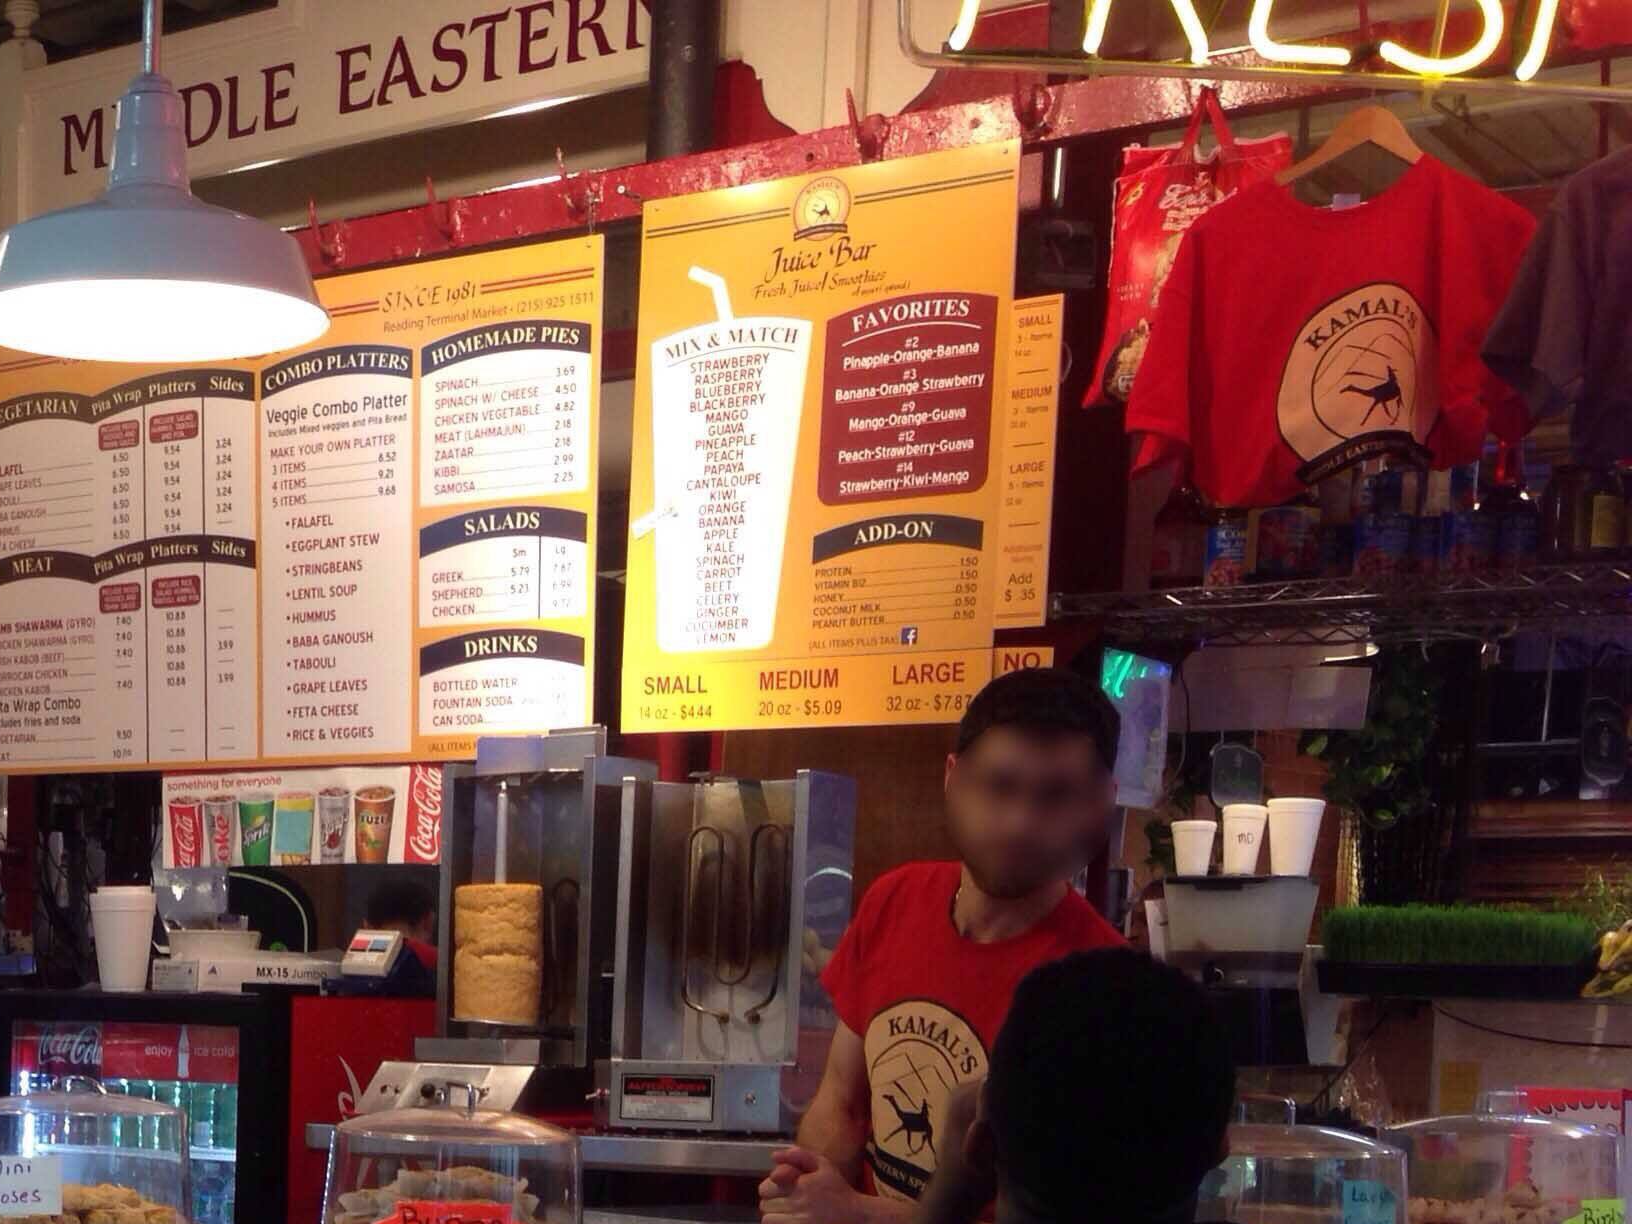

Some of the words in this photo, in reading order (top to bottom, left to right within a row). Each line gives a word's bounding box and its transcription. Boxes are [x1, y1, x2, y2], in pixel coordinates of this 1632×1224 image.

[63, 63, 299, 175] MDDLE
[851, 299, 970, 333] FAVORITES
[1304, 297, 1418, 351] KAMAL'S
[432, 327, 537, 366] HOMEMADE
[541, 326, 580, 345] PIES
[665, 338, 702, 359] MIX
[728, 327, 799, 344] MATCH
[690, 352, 770, 374] STRAWBERRY
[265, 355, 323, 392] COMBO
[327, 352, 409, 372] PLATTERS
[695, 368, 763, 385] RASPBERRY
[435, 378, 479, 393] SPINACH
[695, 381, 762, 399] BLUEBERRY
[922, 373, 985, 391] Strawberry
[112, 388, 142, 407] Wrap
[148, 379, 196, 398] Platters
[209, 377, 245, 392] Sides
[501, 386, 539, 400] CHEESE
[266, 406, 308, 425] Veggie
[312, 399, 359, 419] Combo
[363, 393, 408, 411] Platter
[690, 393, 766, 413] BLACKBERRY
[434, 412, 479, 427] CHICKEN
[481, 404, 540, 422] VEGETABLE
[706, 409, 748, 423] MANGO
[849, 407, 966, 432] Mango-Orange-Guava
[708, 422, 745, 437] GUAVA
[695, 434, 756, 450] PINEAPPLE
[706, 450, 744, 462] PEACH
[838, 438, 974, 464] Peach-Strawberry-Guava
[704, 462, 745, 475] PAPAYA
[840, 470, 969, 494] Strawberry-Kiwi-Mango
[710, 489, 737, 501] KIWI
[698, 501, 746, 515] ORANGE
[291, 515, 334, 529] FALAFEL
[464, 511, 541, 536] SALADS
[698, 514, 745, 528] BANANA
[854, 520, 935, 545] ADD-ON
[291, 537, 345, 552] EGGPLANT
[350, 533, 380, 547] STEW
[12, 557, 54, 574] MEAT
[116, 550, 145, 569] Wrap
[150, 542, 198, 558] Platters
[211, 541, 246, 558] Sides
[292, 560, 363, 577] STRINGBEANS
[815, 567, 852, 577] PROTEIN
[1008, 573, 1033, 585] Add
[292, 586, 327, 600] LENTIL
[330, 584, 358, 597] SOUP
[292, 609, 336, 624] HUMMUS
[813, 605, 857, 616] COCONUT
[812, 618, 847, 630] PEANUT
[849, 616, 885, 626] BUTTER
[292, 635, 319, 648] BABA
[323, 631, 373, 646] GANOUSH
[464, 635, 538, 658] DRINKS
[293, 657, 336, 670] TABOULI
[759, 668, 840, 691] MEDIUM
[892, 662, 966, 685] LARGE
[293, 682, 326, 695] GRAPE
[329, 680, 368, 693] LEAVES
[643, 676, 708, 695] SMALL
[292, 705, 317, 718] FETA
[320, 703, 359, 716] CHEESE
[804, 700, 842, 716] $5.09
[292, 729, 315, 741] RICE
[330, 726, 374, 739] VEGGIES
[168, 777, 218, 792] something
[221, 776, 236, 789] for
[237, 776, 282, 789] everyone
[256, 967, 289, 979] MX-15
[145, 1044, 173, 1059] enjoy
[194, 1046, 209, 1057] ice
[888, 1015, 978, 1075] KAMAL'S
